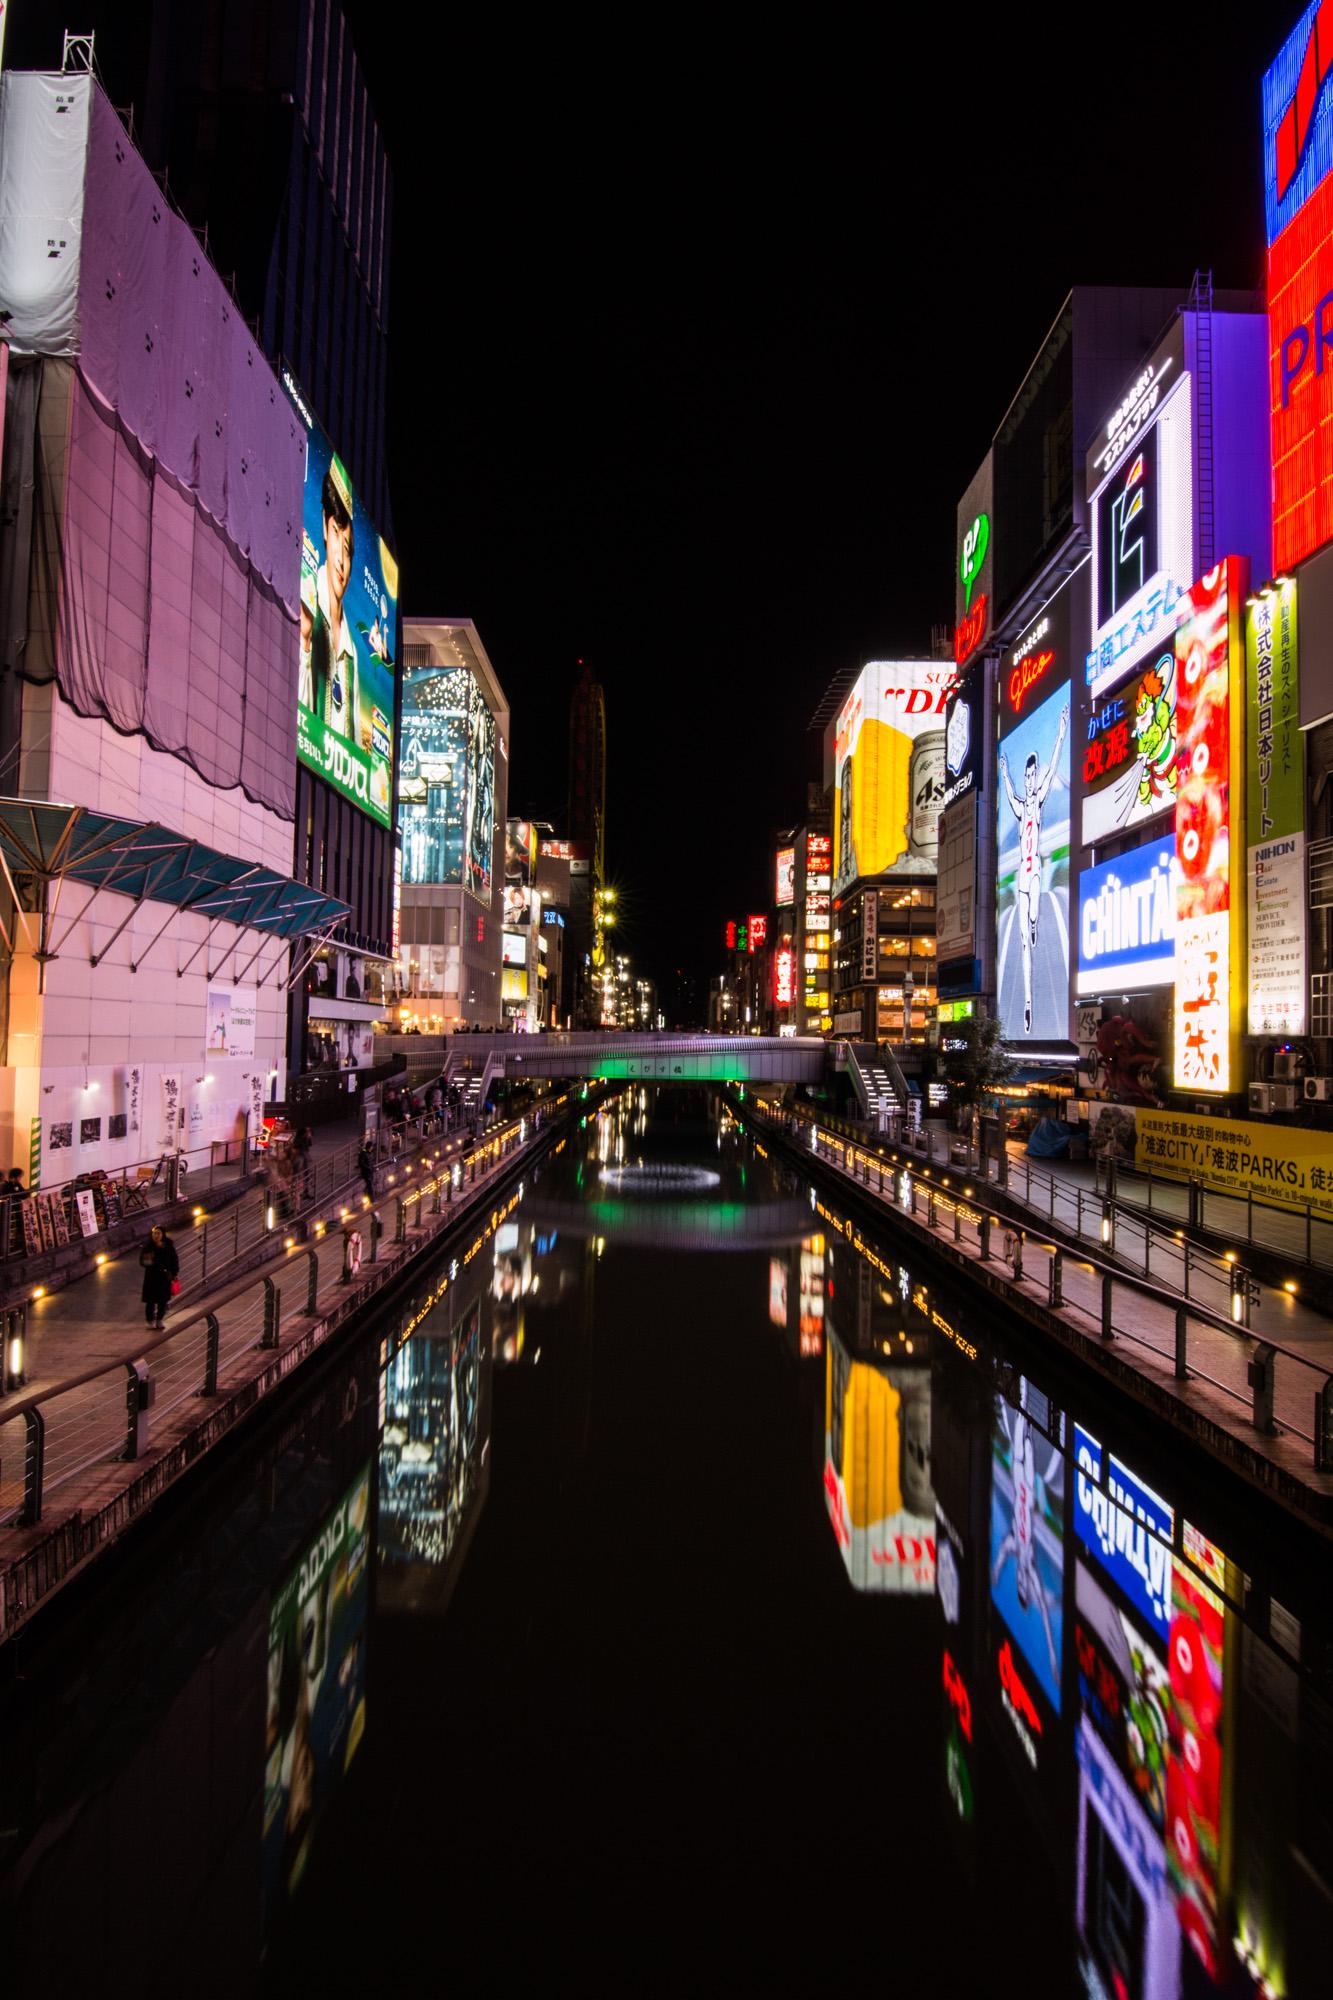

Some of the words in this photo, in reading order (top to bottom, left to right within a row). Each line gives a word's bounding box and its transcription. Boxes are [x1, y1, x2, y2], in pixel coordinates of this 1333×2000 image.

[955, 593, 986, 665] ピップ
[925, 672, 961, 685] SUP
[1009, 651, 1054, 713] Glico
[1280, 591, 1291, 776] 不動産再生のスペシャリスト
[1087, 698, 1124, 739] かぜに
[1257, 604, 1273, 838] 株式会社日本リート
[1083, 720, 1128, 783] 改源
[323, 730, 369, 804] サロンパス
[542, 843, 569, 853] 免税
[1256, 840, 1295, 862] NIHON
[1256, 863, 1273, 875] Real
[1256, 876, 1278, 888] Estate
[1256, 888, 1288, 900] Investment
[1256, 901, 1289, 912] Technology
[1256, 912, 1280, 922] SERVICE
[1256, 920, 1286, 931] PROVIDER
[1240, 1180, 1249, 1188] and
[1292, 1190, 1319, 1205] 10-minute
